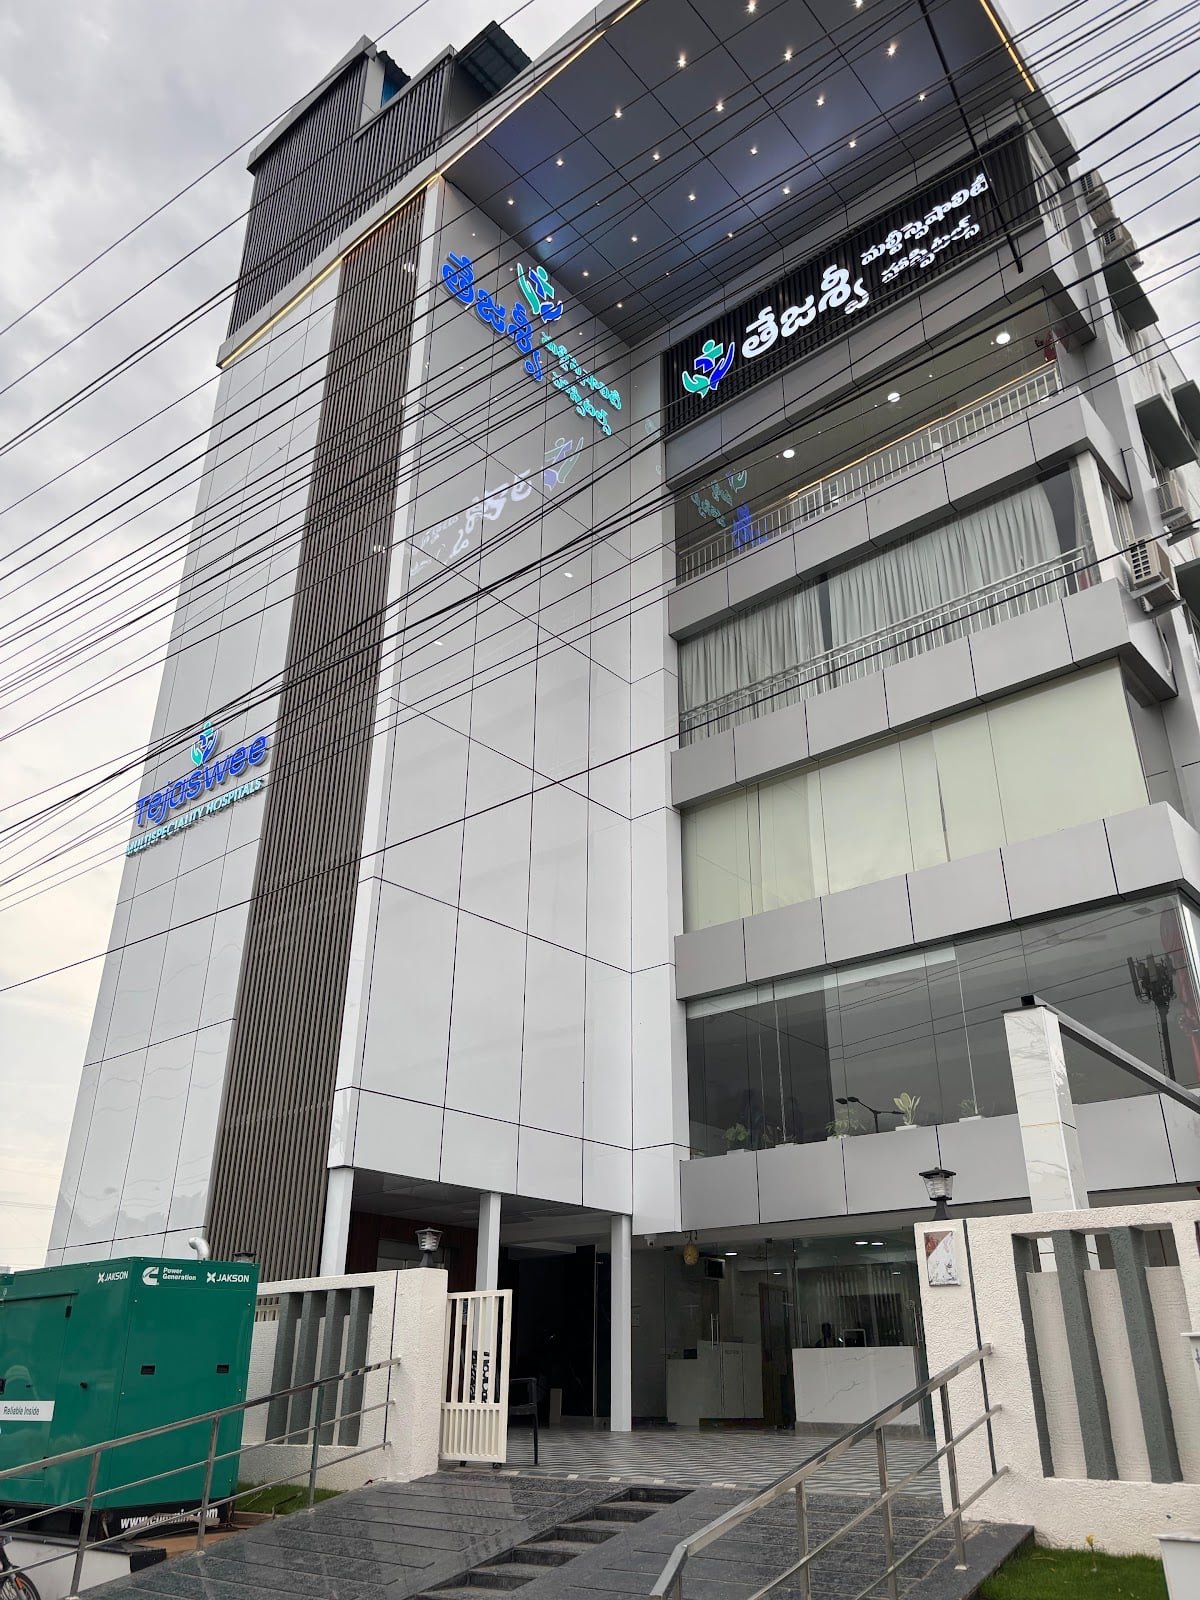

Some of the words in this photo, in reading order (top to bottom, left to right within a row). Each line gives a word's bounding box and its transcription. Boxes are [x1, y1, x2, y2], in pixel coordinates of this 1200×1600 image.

[135, 734, 268, 826] Tejaswee
[126, 805, 205, 856] MULTISPECIALITY
[206, 778, 264, 815] HOSPITALS
[104, 1270, 129, 1281] JAKSON
[162, 1273, 197, 1281] Generation
[216, 1273, 250, 1283] JAKSON
[3, 1406, 23, 1415] Reliable
[24, 1406, 40, 1415] Inside
